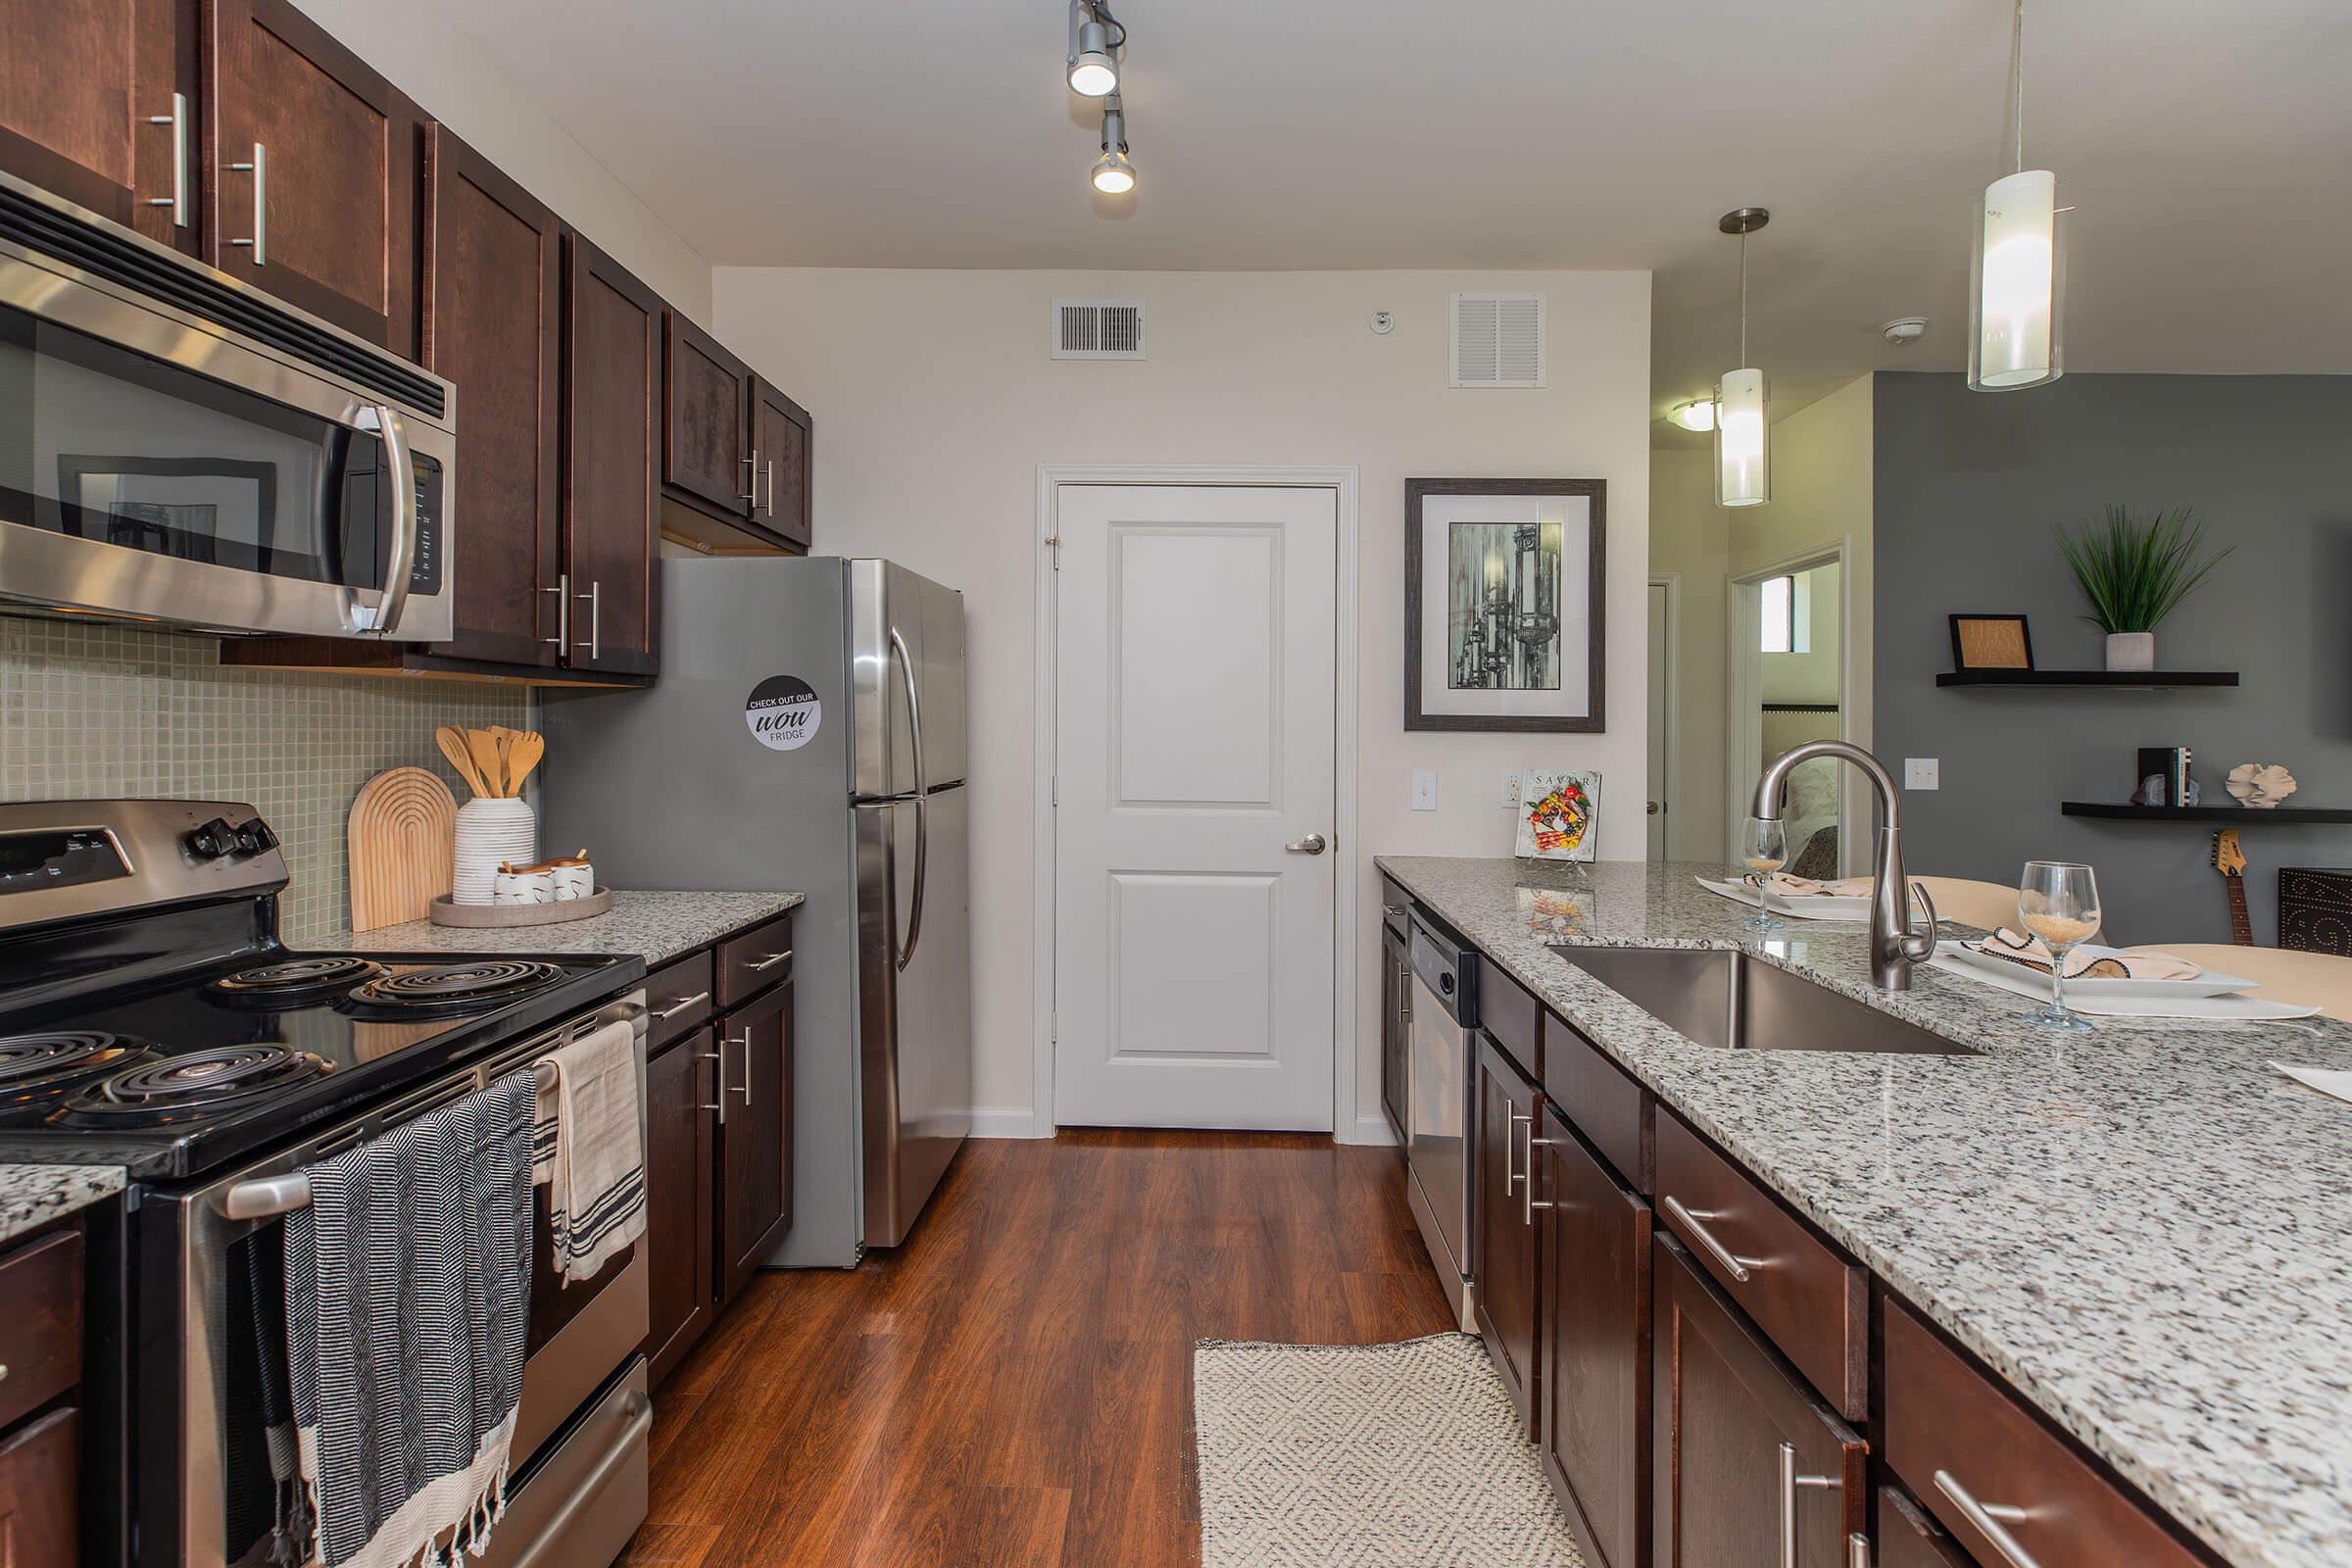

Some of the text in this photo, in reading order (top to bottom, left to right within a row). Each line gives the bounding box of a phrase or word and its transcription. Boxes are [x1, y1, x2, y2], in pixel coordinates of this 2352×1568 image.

[750, 692, 813, 709] CHECK OUT OUR
[769, 729, 805, 742] FRIDGE
[1536, 775, 1591, 786] SAVOR
